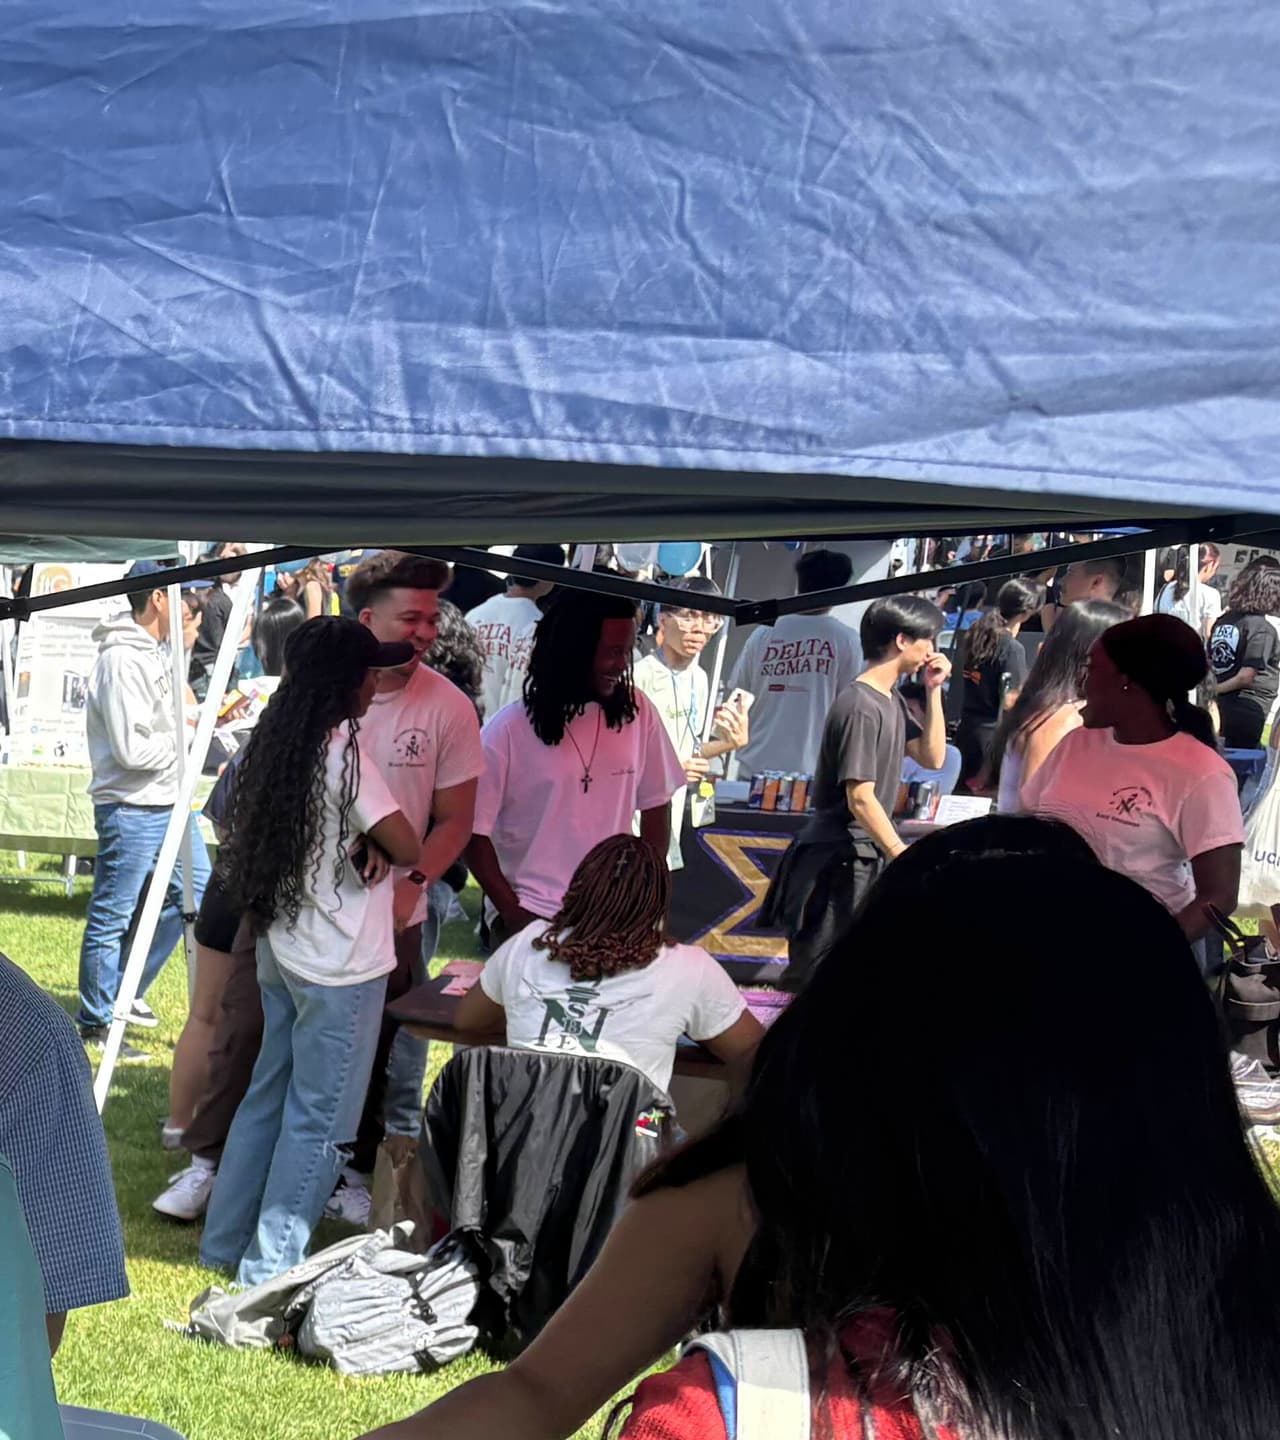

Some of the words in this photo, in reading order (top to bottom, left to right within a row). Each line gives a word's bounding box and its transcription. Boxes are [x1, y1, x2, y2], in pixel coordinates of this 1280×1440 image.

[762, 639, 835, 662] DELTA
[760, 659, 811, 677] SIGMA
[815, 659, 831, 675] PI
